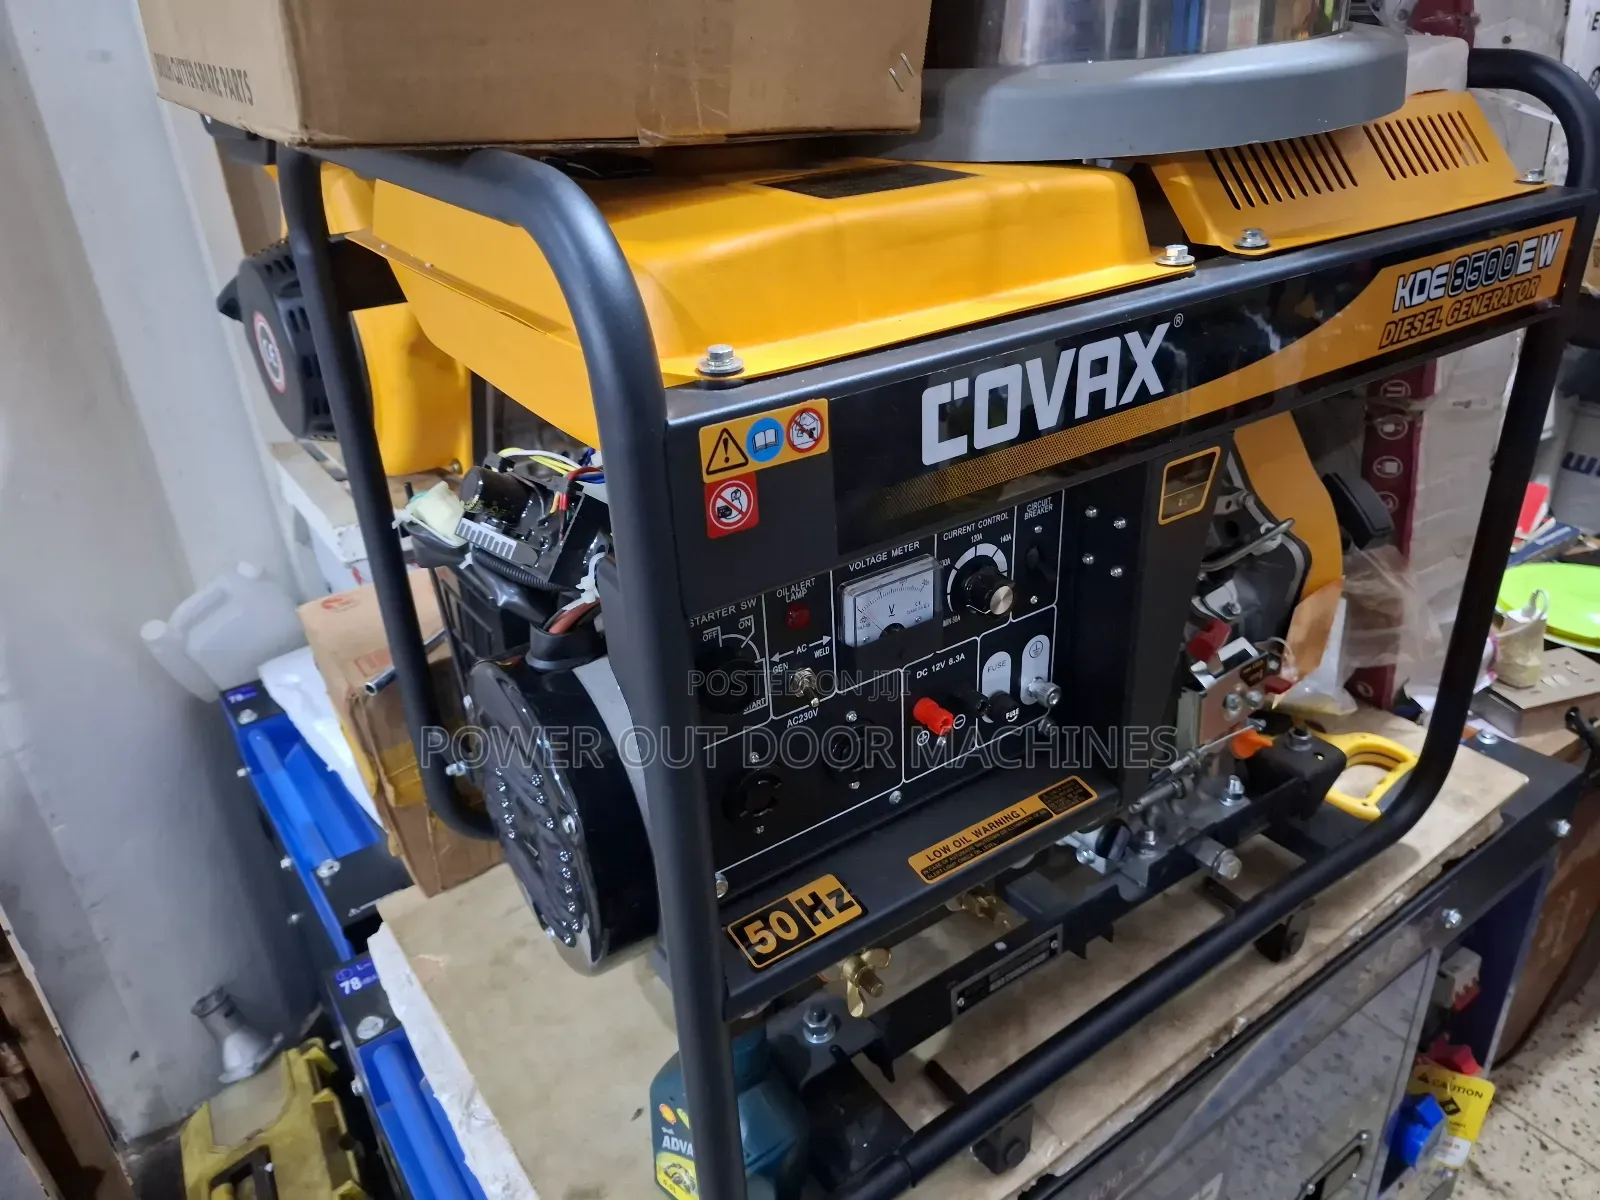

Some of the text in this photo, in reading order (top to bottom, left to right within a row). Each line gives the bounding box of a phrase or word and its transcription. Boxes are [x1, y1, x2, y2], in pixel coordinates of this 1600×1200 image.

[219, 65, 254, 106] PARTS
[1378, 275, 1541, 349] DIESEL GENERATOR
[921, 321, 1171, 466] COVAX
[1024, 503, 1053, 520] BREAKER
[1026, 496, 1052, 512] CIRCUIT
[943, 511, 1009, 541] CURRENT CONTROL
[848, 541, 920, 572] VOLTAGE METER
[776, 577, 816, 598] OIL ALERT
[785, 588, 808, 603] LAMP
[690, 597, 757, 628] STARTER SW
[738, 618, 752, 630] ON
[702, 630, 718, 642] OFF
[796, 643, 808, 654] AC
[813, 646, 830, 659] WELD
[772, 662, 789, 675] GEN
[916, 668, 928, 679] DC
[931, 661, 946, 673] 12V
[987, 659, 1007, 673] FUSE
[786, 708, 819, 728] AC230V
[1005, 707, 1020, 719] FUSE
[925, 844, 951, 862] LOW
[952, 836, 972, 849] OIL
[971, 810, 1020, 838] WARNING
[743, 910, 799, 954] 50
[339, 976, 363, 995] 78
[1432, 1079, 1484, 1100] CAUTION
